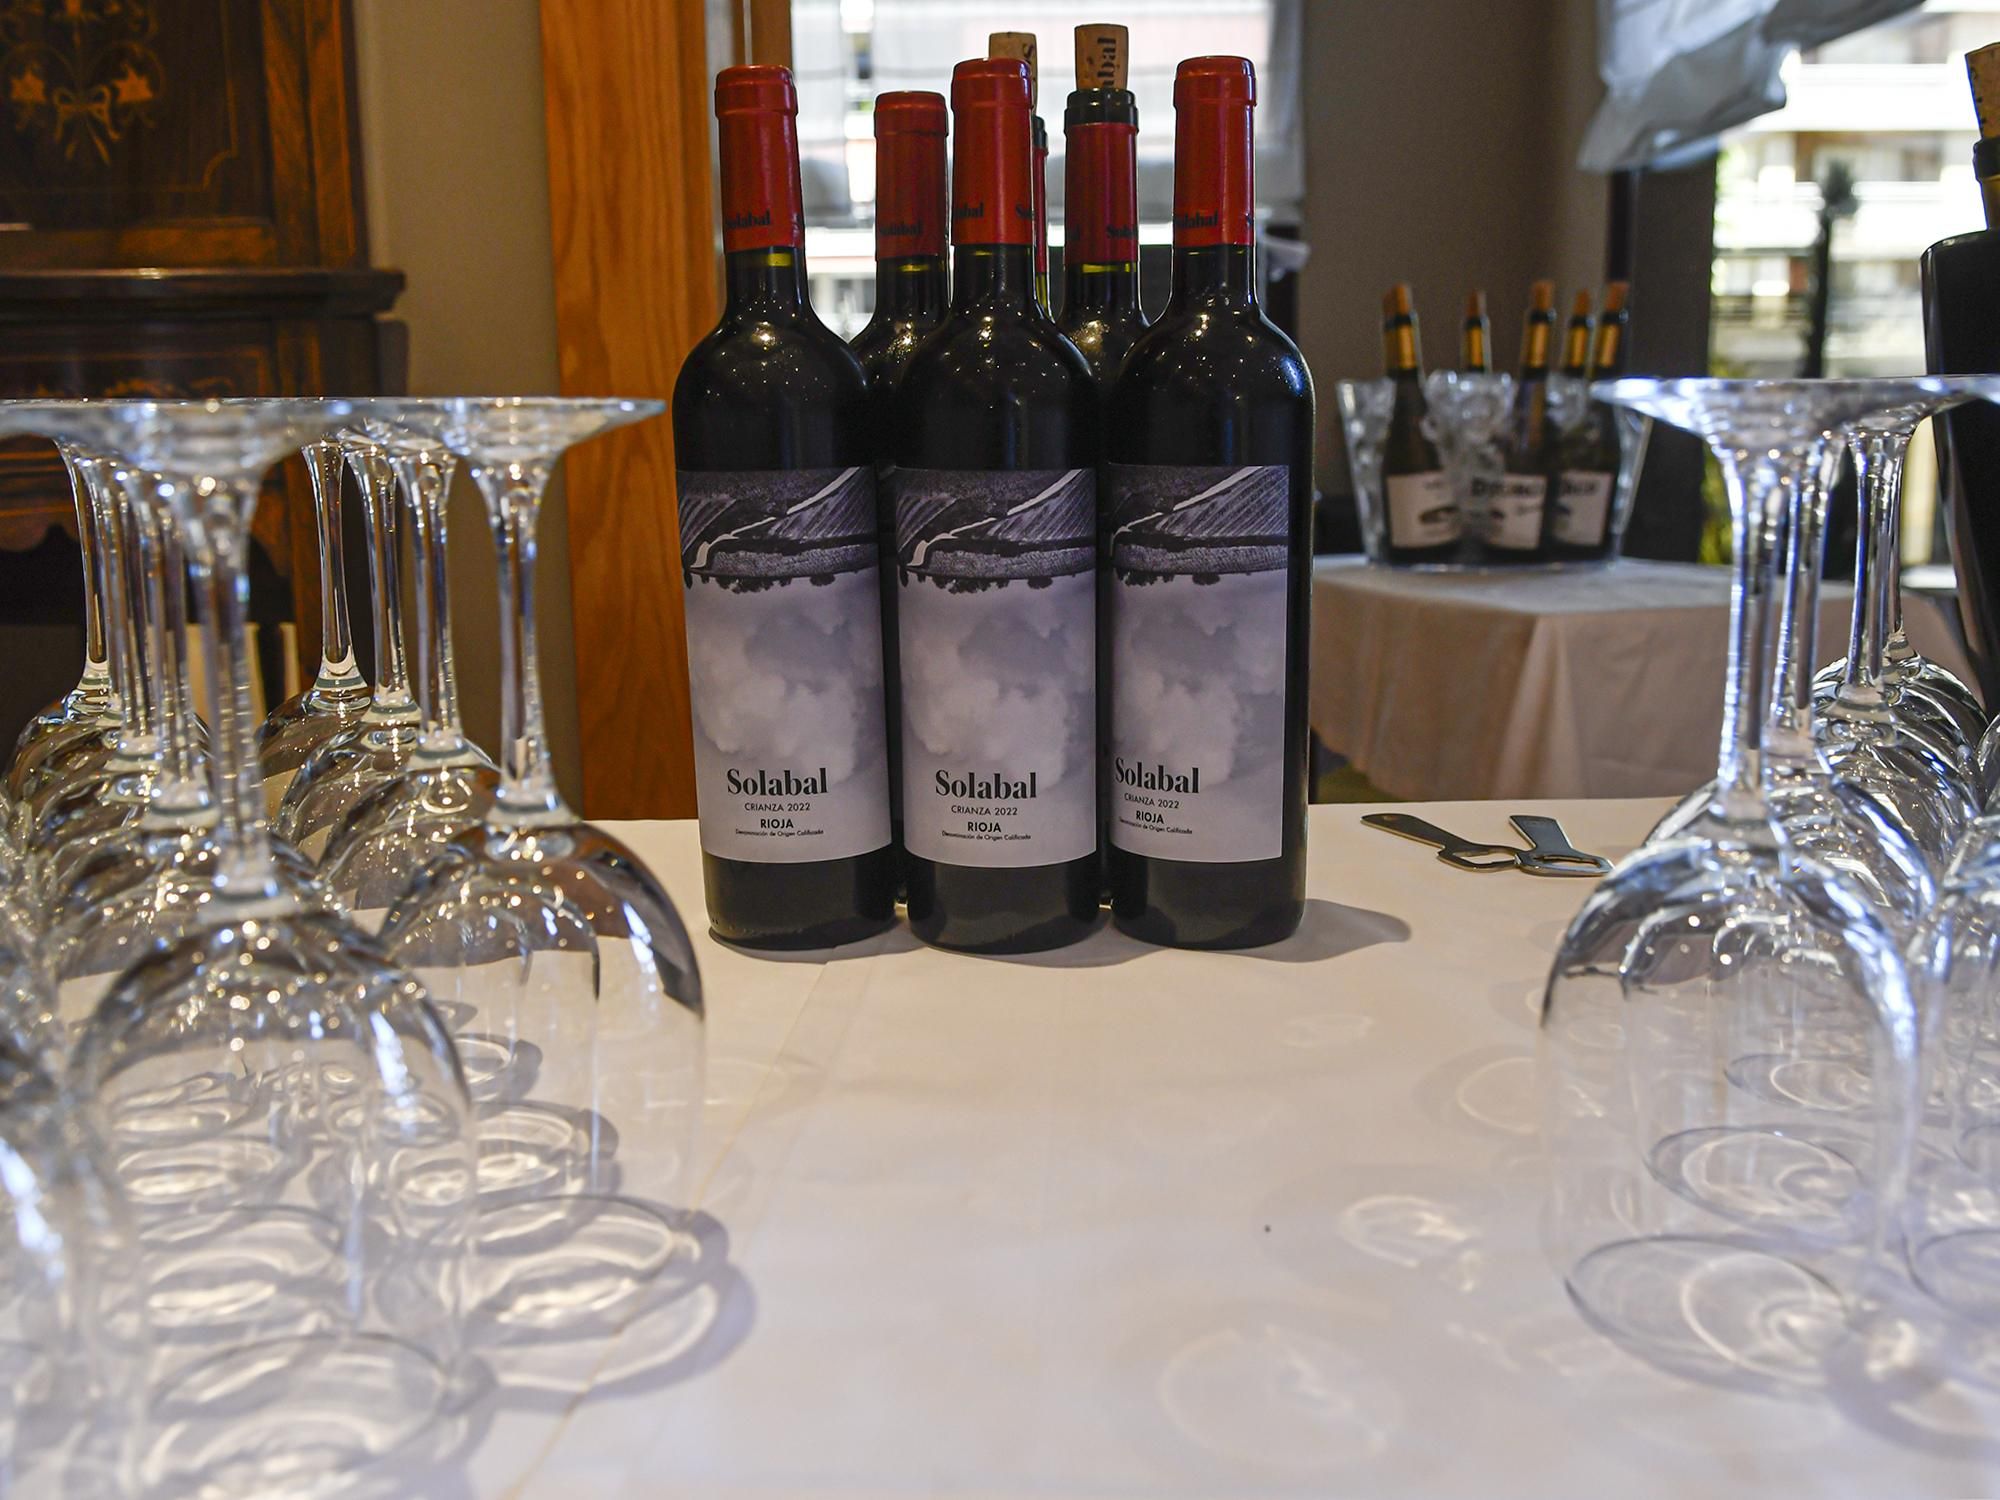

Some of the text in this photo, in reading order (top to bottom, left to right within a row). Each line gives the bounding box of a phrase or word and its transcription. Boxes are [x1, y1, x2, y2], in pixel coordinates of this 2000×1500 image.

[1115, 756, 1200, 794] Solabal
[727, 767, 830, 797] Solabal
[935, 769, 1037, 800] Solabal
[1124, 792, 1180, 809] CRIANZA 2022
[744, 802, 811, 812] CRIANZA 2022
[951, 805, 1018, 816] CRIANZA 2022
[760, 818, 794, 829] RIOJA
[1136, 810, 1164, 825] RIOJA
[967, 821, 1002, 833] RIOJA
[777, 830, 796, 838] Origen
[984, 833, 1004, 842] Origen
